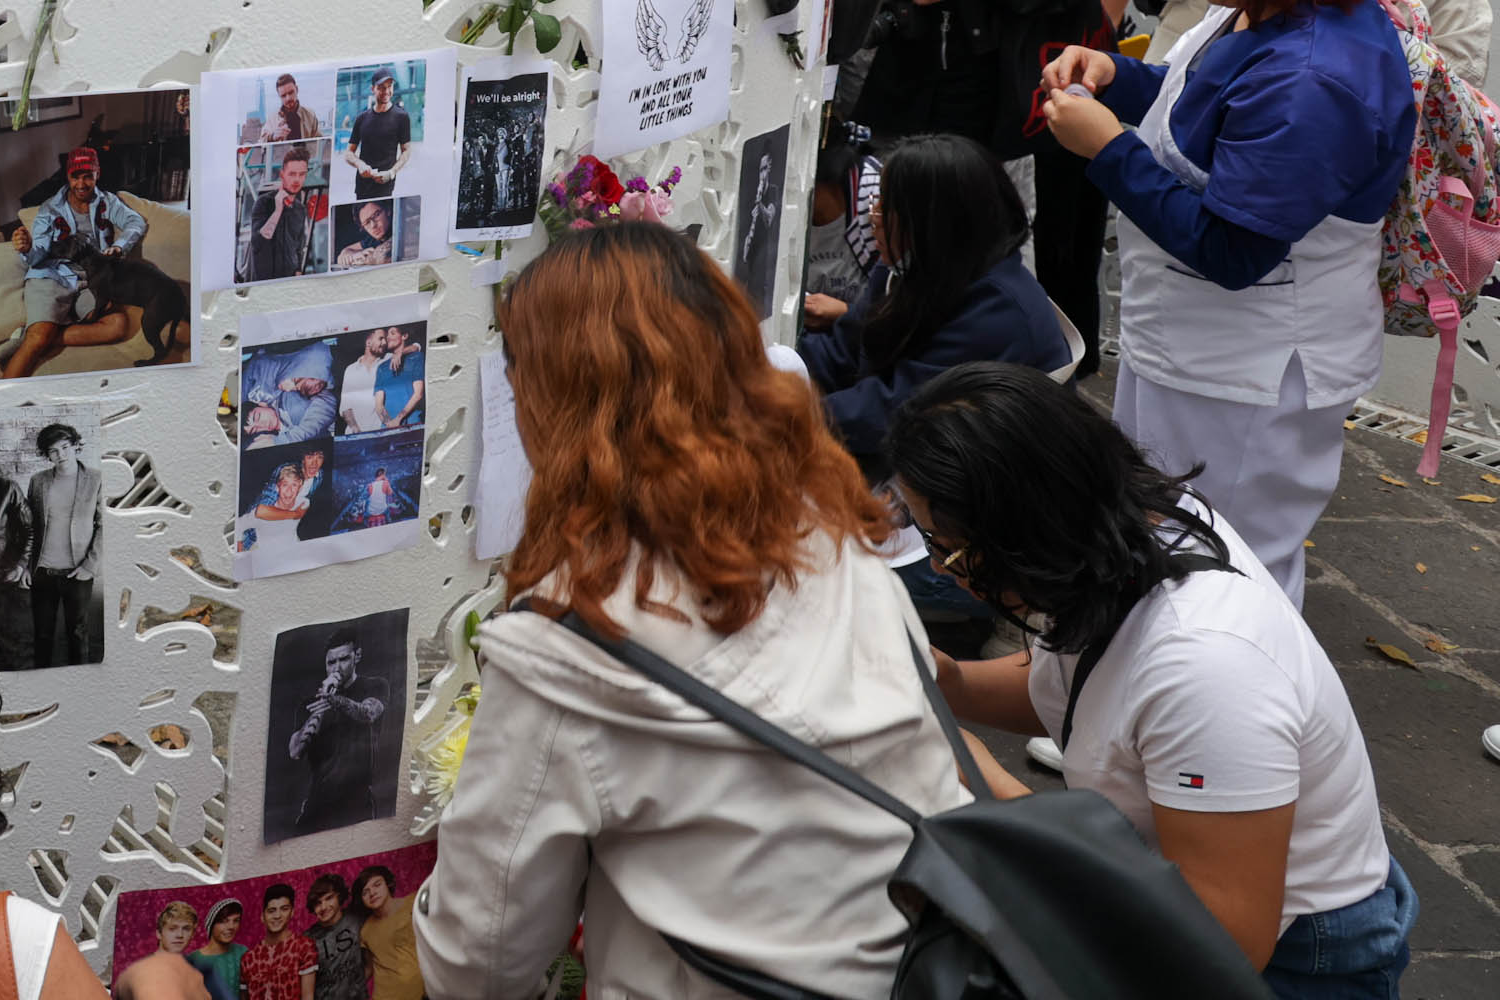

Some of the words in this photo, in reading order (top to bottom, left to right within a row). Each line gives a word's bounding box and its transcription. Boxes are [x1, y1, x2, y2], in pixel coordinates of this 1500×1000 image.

[476, 94, 500, 104] We'll
[501, 94, 512, 103] be
[513, 91, 541, 103] alright
[629, 88, 642, 103] I'M
[642, 84, 651, 98] IN
[653, 79, 671, 95] LOVE
[673, 73, 691, 89] WITH
[692, 67, 708, 83] YOU
[640, 97, 656, 115] AND
[657, 93, 671, 108] ALL
[672, 87, 693, 104] YOUR
[639, 110, 665, 131] LITTLE
[665, 102, 694, 122] THINGS
